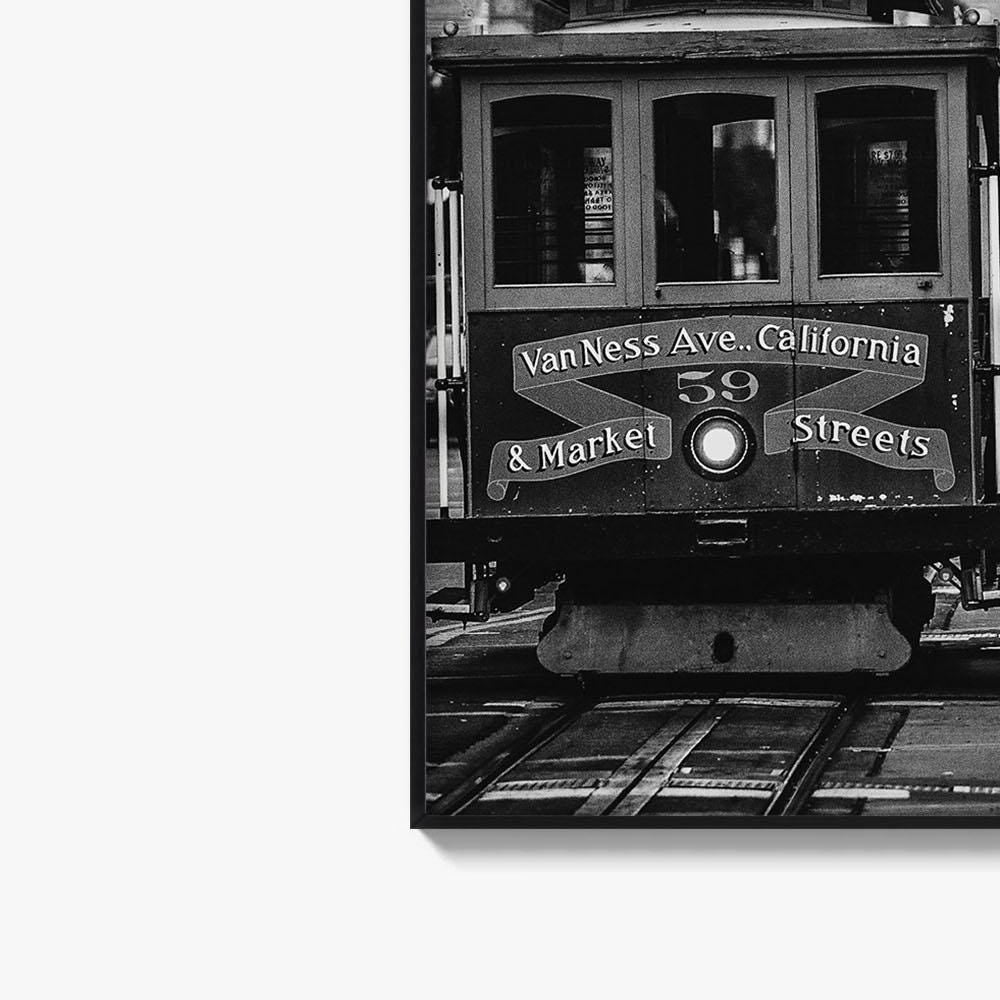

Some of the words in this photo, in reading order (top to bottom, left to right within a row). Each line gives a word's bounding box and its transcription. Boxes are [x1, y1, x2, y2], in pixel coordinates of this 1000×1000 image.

[519, 347, 577, 377] Van
[580, 334, 660, 366] Ness
[757, 323, 921, 366] California
[677, 369, 759, 404] 59
[508, 444, 533, 472] &
[538, 421, 657, 470] Market
[792, 414, 931, 457] Streets
